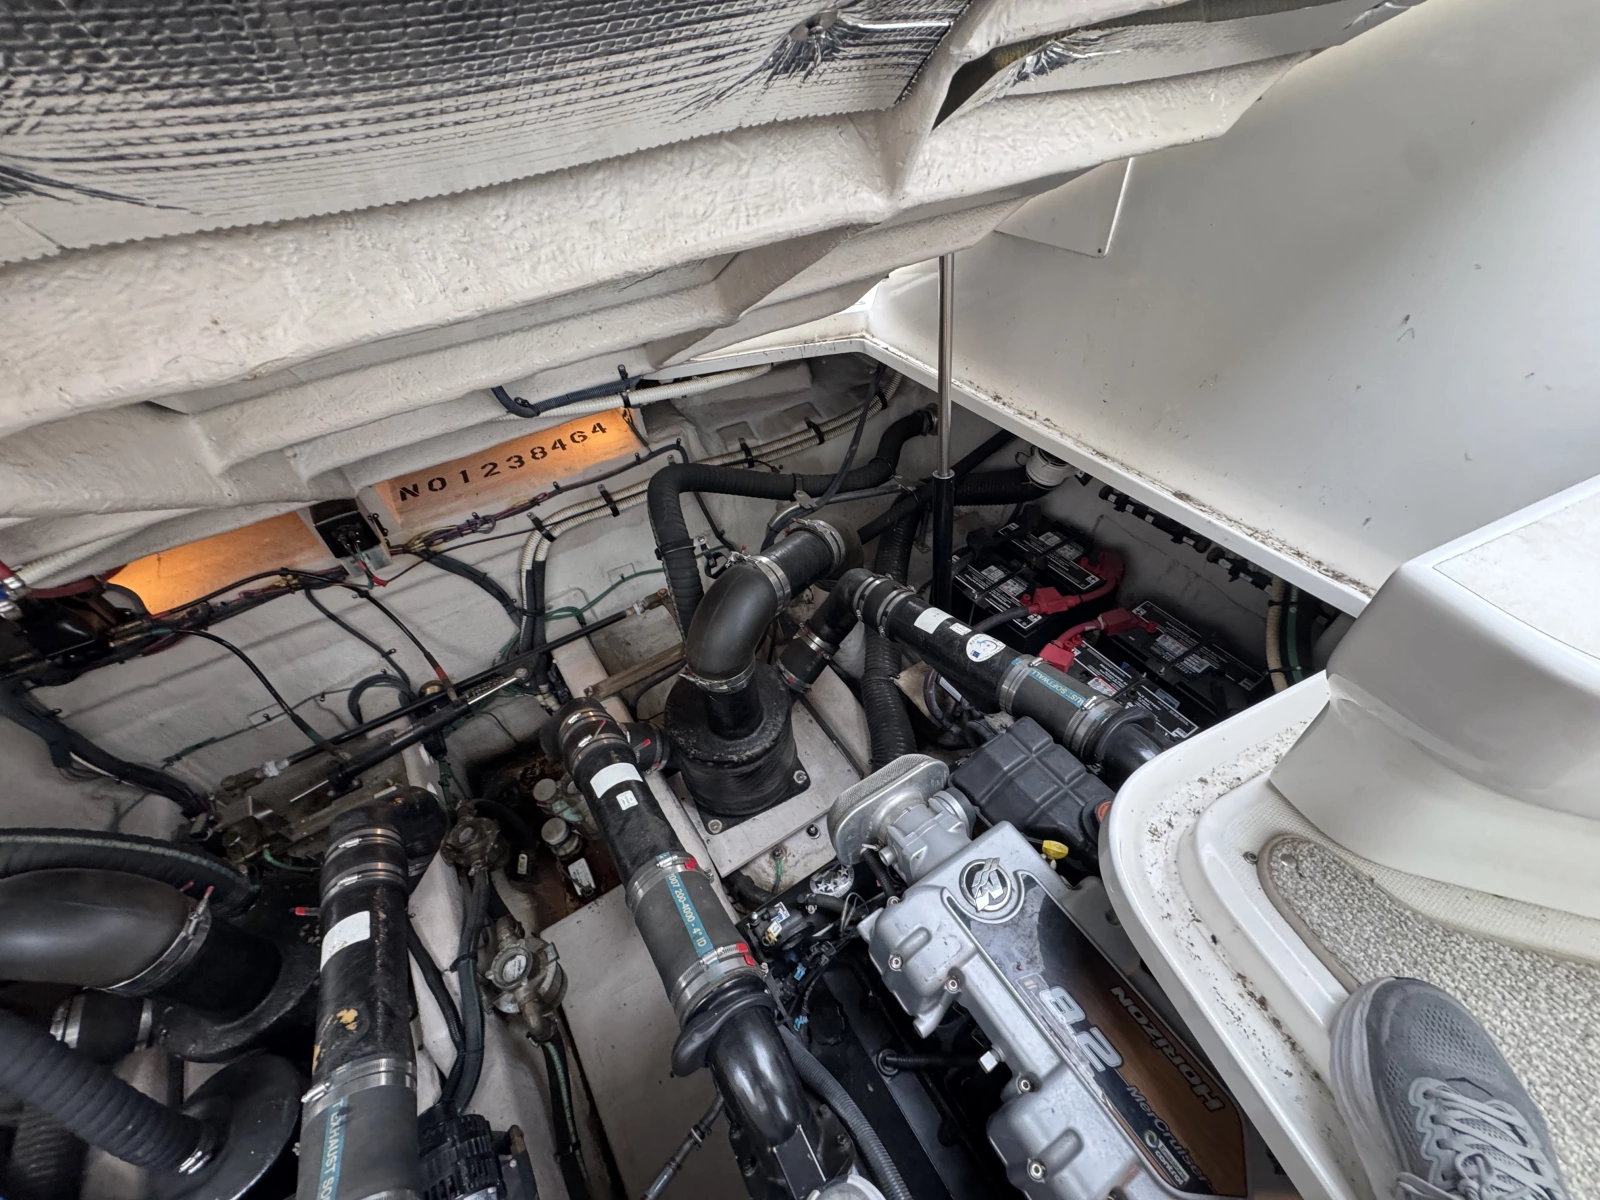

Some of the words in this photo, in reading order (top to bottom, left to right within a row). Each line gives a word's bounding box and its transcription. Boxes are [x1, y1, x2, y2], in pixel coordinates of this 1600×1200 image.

[1032, 669, 1067, 694] SOFTWALL
[675, 888, 695, 922] 200-4000
[696, 937, 707, 947] ID
[1039, 985, 1124, 1073] 8.2
[325, 1111, 342, 1175] EXHAUST
[1126, 1086, 1209, 1182] MerCruiser
[1155, 1150, 1185, 1186] control
